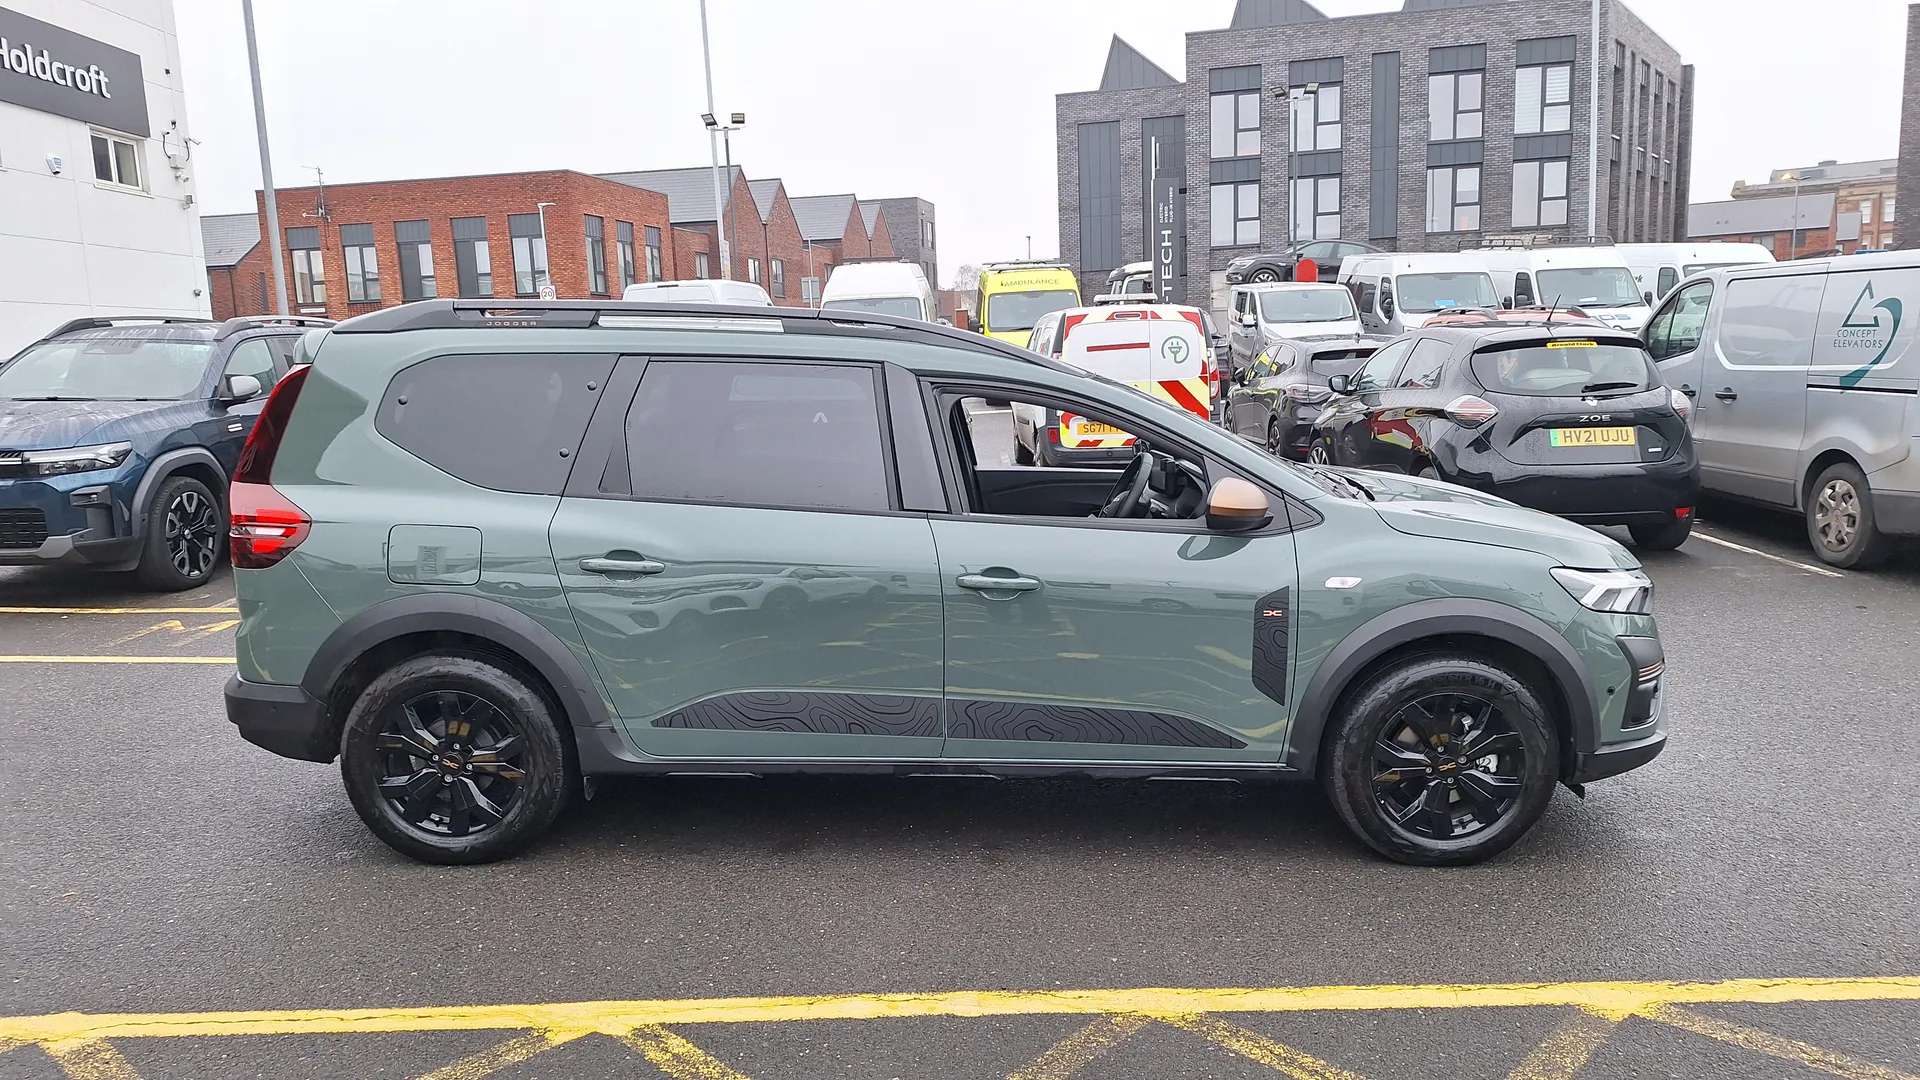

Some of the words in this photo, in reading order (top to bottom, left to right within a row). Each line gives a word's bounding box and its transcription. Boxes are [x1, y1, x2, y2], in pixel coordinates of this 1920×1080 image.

[1161, 229, 1173, 304] -TECH
[543, 290, 553, 298] 20
[1836, 329, 1877, 338] CONCEPT
[1833, 339, 1883, 349] ELEVATORS
[1578, 414, 1612, 423] ZOE
[1563, 430, 1597, 443] HV21
[1601, 429, 1630, 442] UJU
